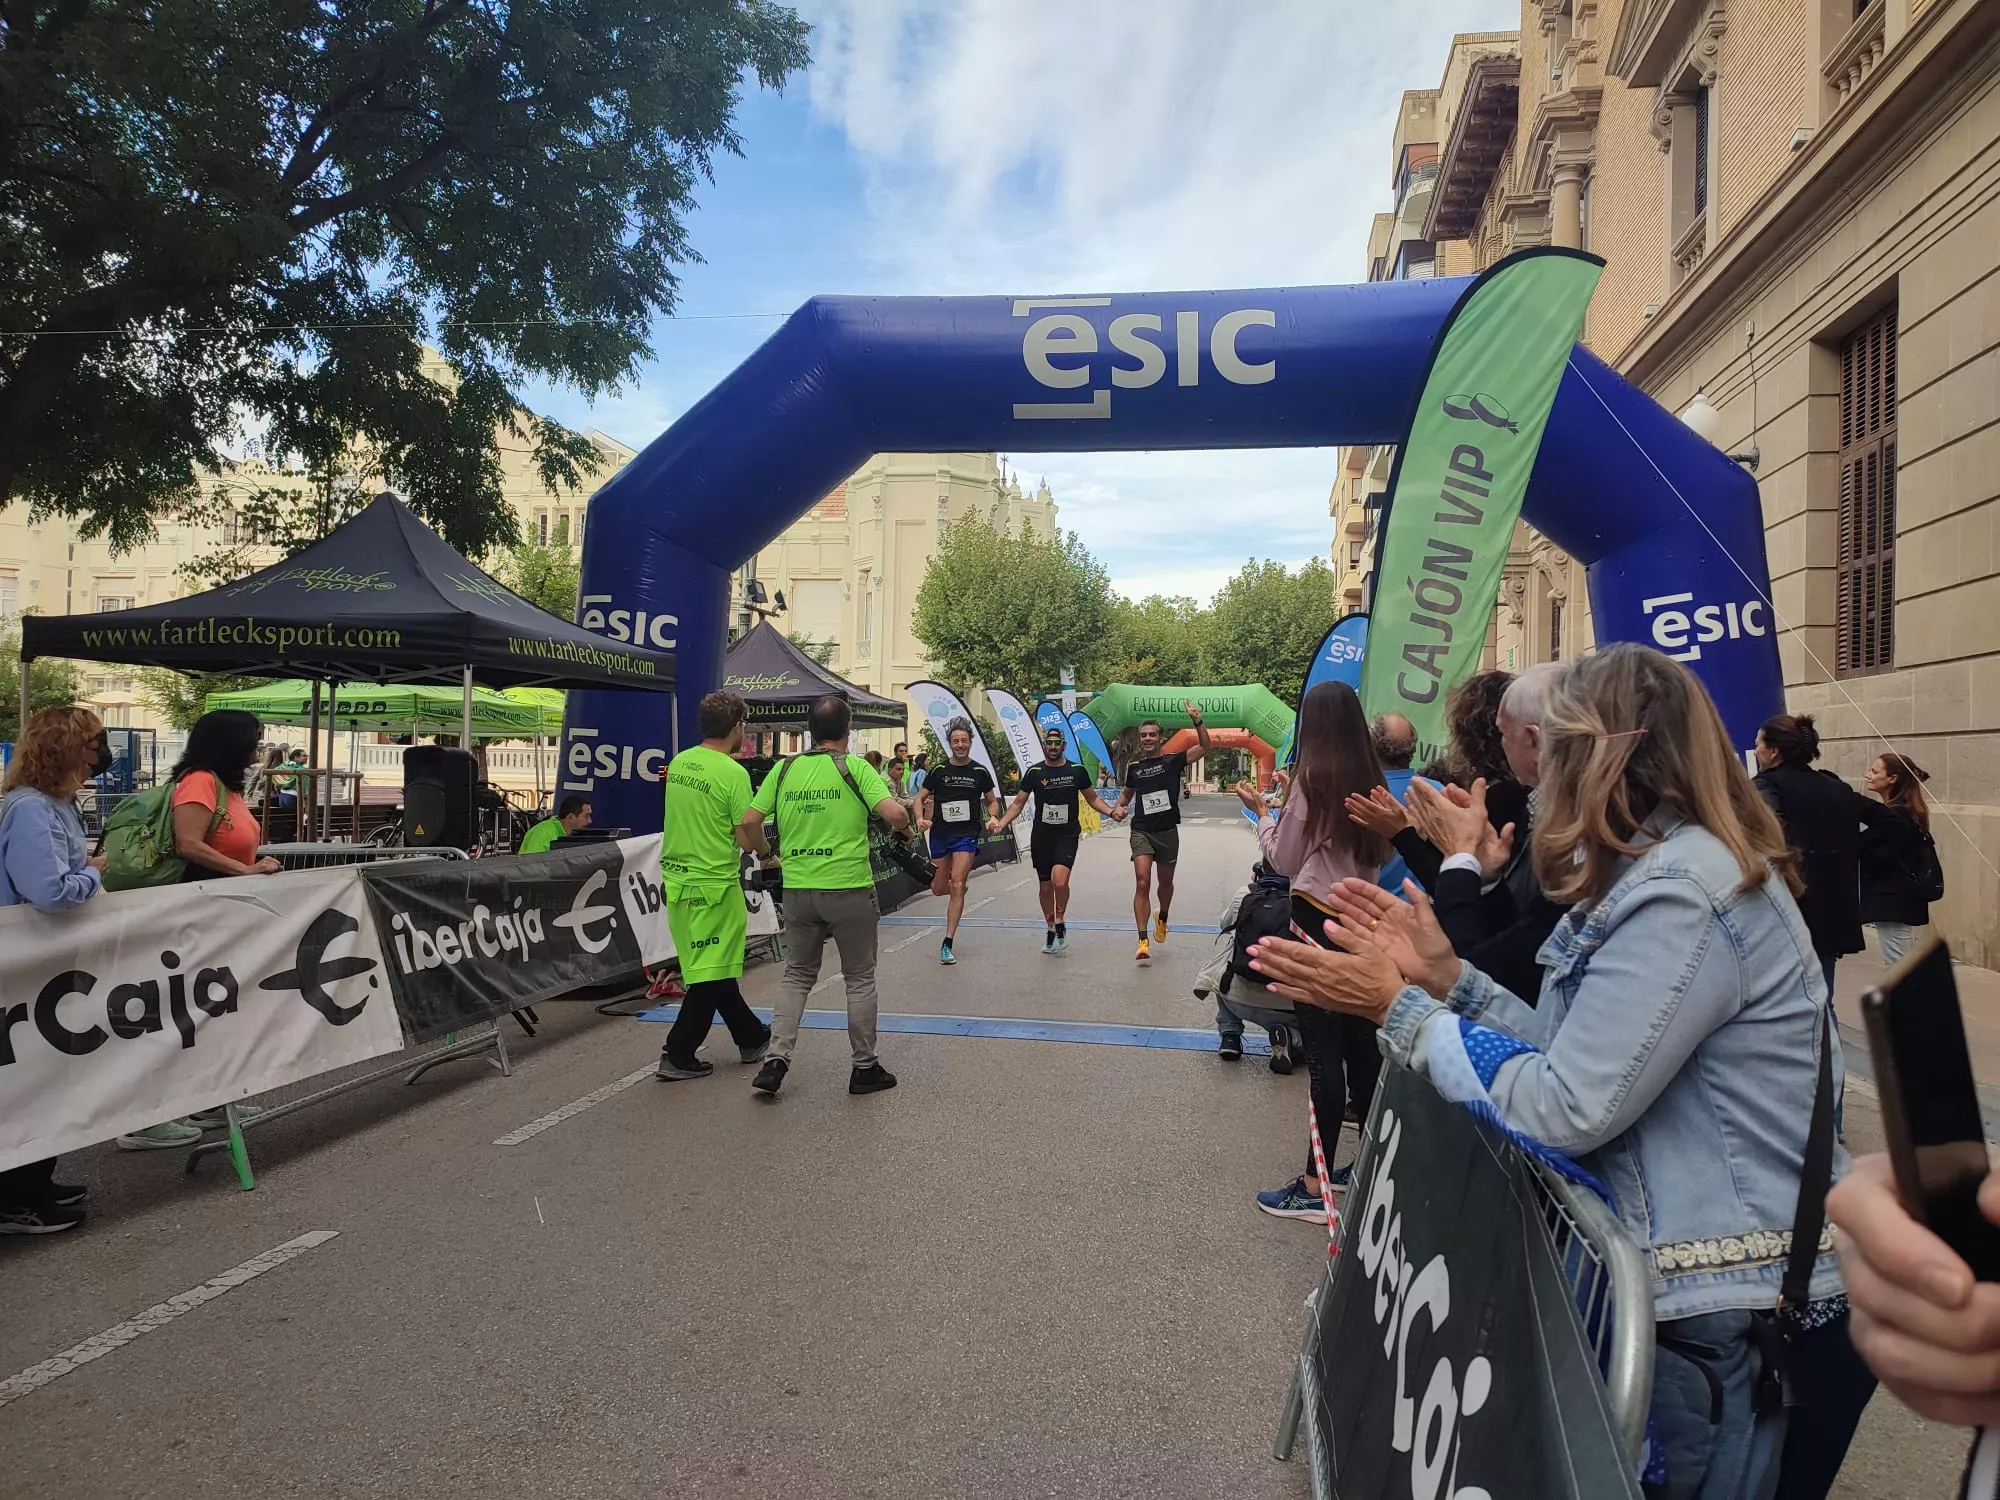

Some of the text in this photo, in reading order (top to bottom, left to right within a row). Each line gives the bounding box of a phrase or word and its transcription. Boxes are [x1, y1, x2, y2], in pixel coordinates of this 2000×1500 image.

[1397, 444, 1494, 704] CAJÓN VIP
[82, 617, 401, 653] www.fartlecksport.com
[508, 637, 656, 676] www.fartlecksport.com
[1197, 696, 1236, 713] SPORT
[785, 787, 841, 802] ORGANIZACIÓN
[1149, 798, 1161, 807] 93
[949, 806, 961, 814] 92
[628, 871, 667, 916] ib
